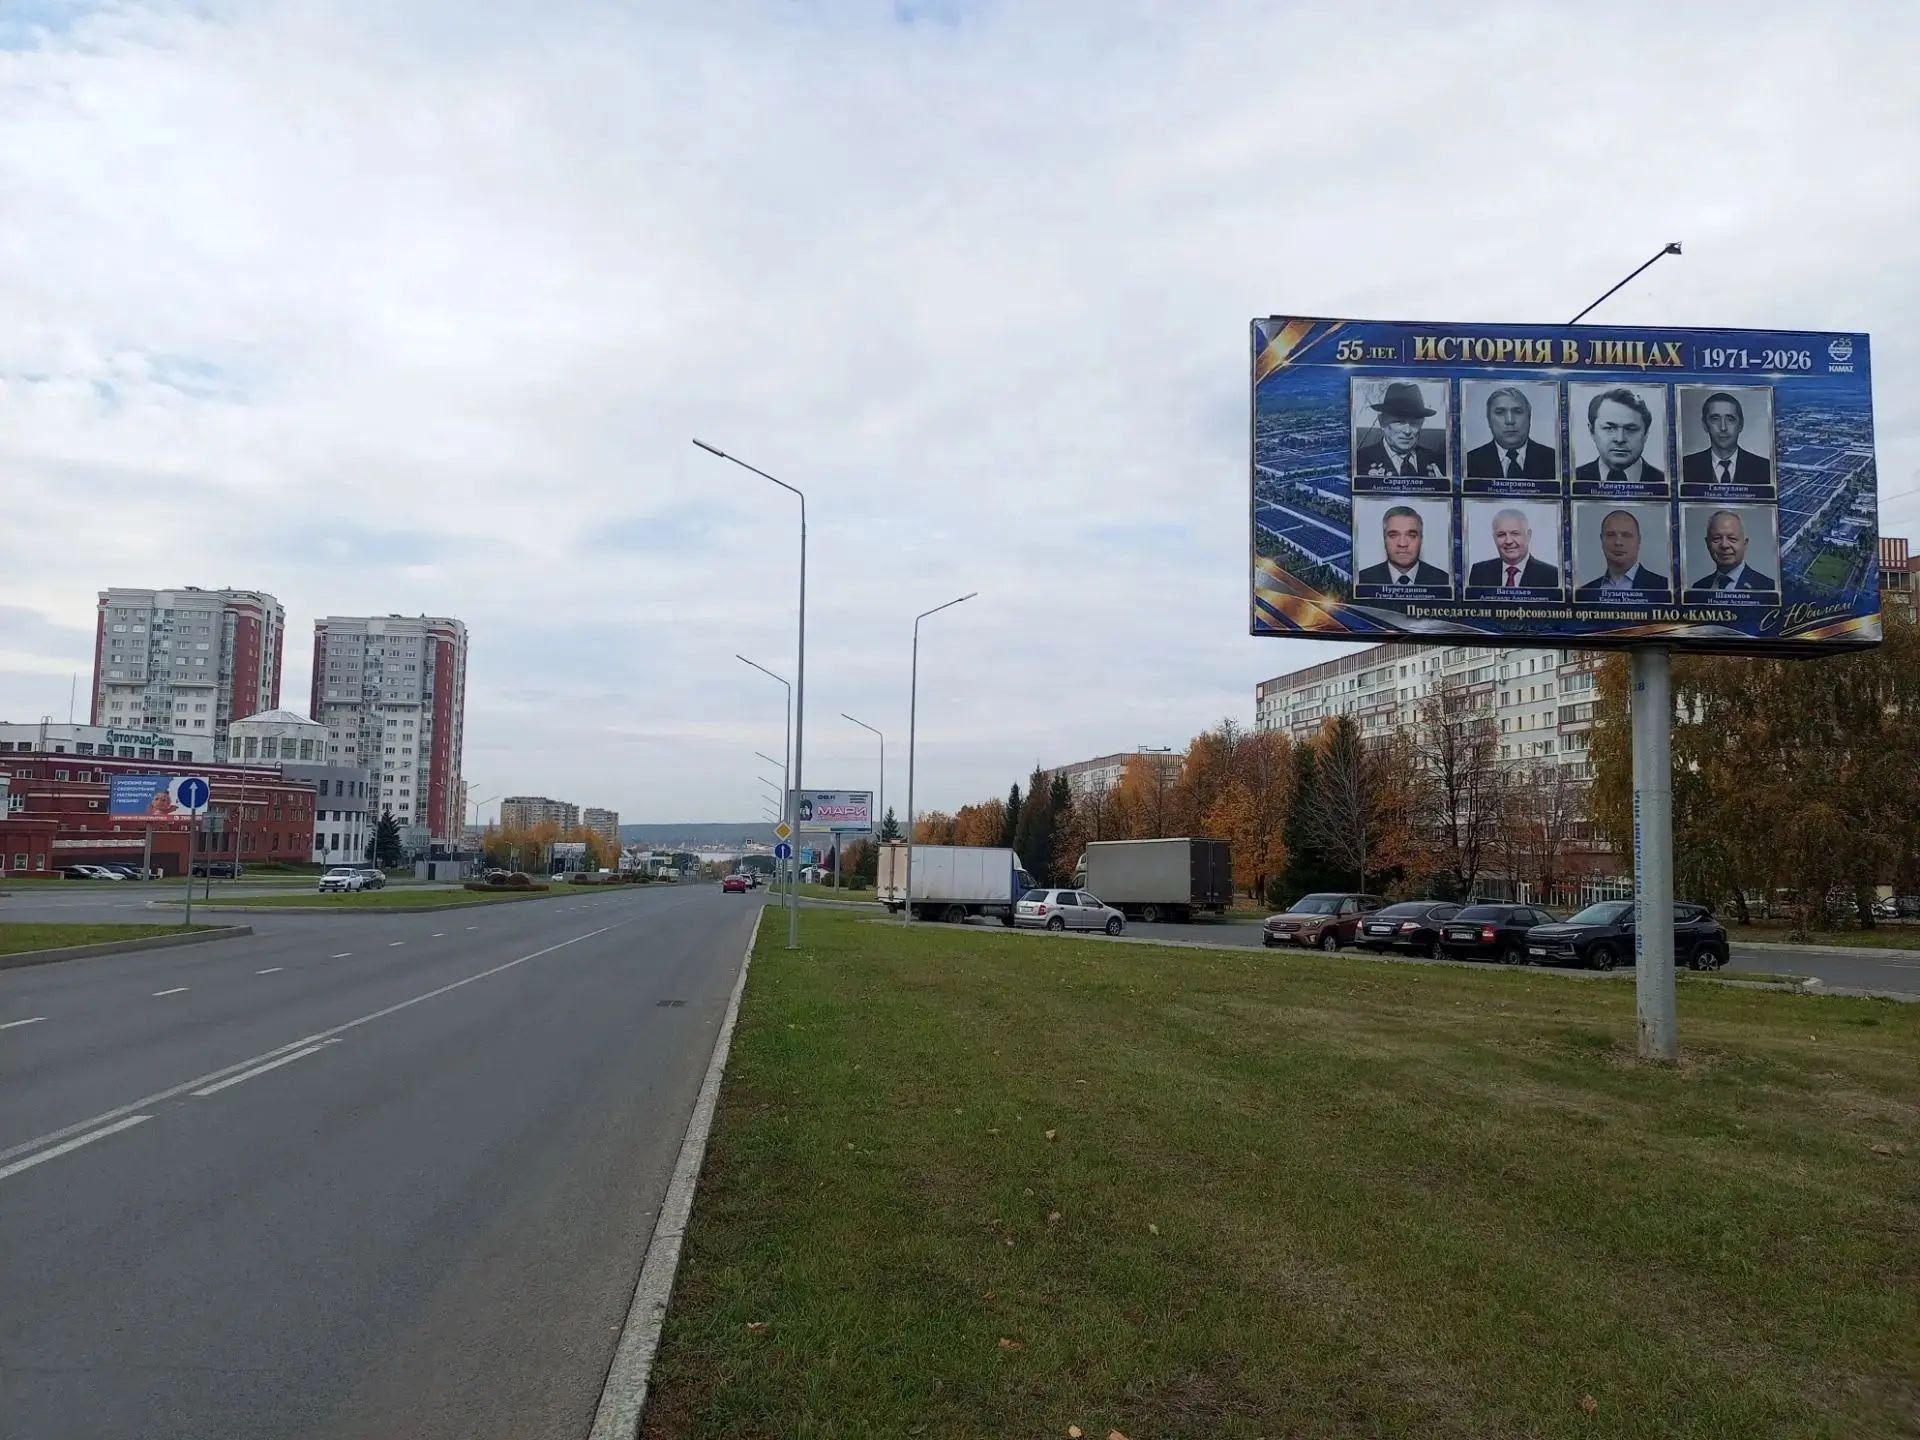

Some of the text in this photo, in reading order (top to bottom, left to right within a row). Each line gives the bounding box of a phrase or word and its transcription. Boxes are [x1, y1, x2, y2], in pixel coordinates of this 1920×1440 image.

[1336, 340, 1398, 361] 55 ЛЕТ.
[1413, 336, 1684, 371] ИСТОРИЯ В ЛИЦАХ
[1383, 477, 1424, 486] Сарапулов
[1496, 587, 1532, 595] Васильев
[1407, 604, 1738, 621] Председатели профсоюзной организации ПАО «КАМАЗ»
[817, 806, 868, 817] МАРИ
